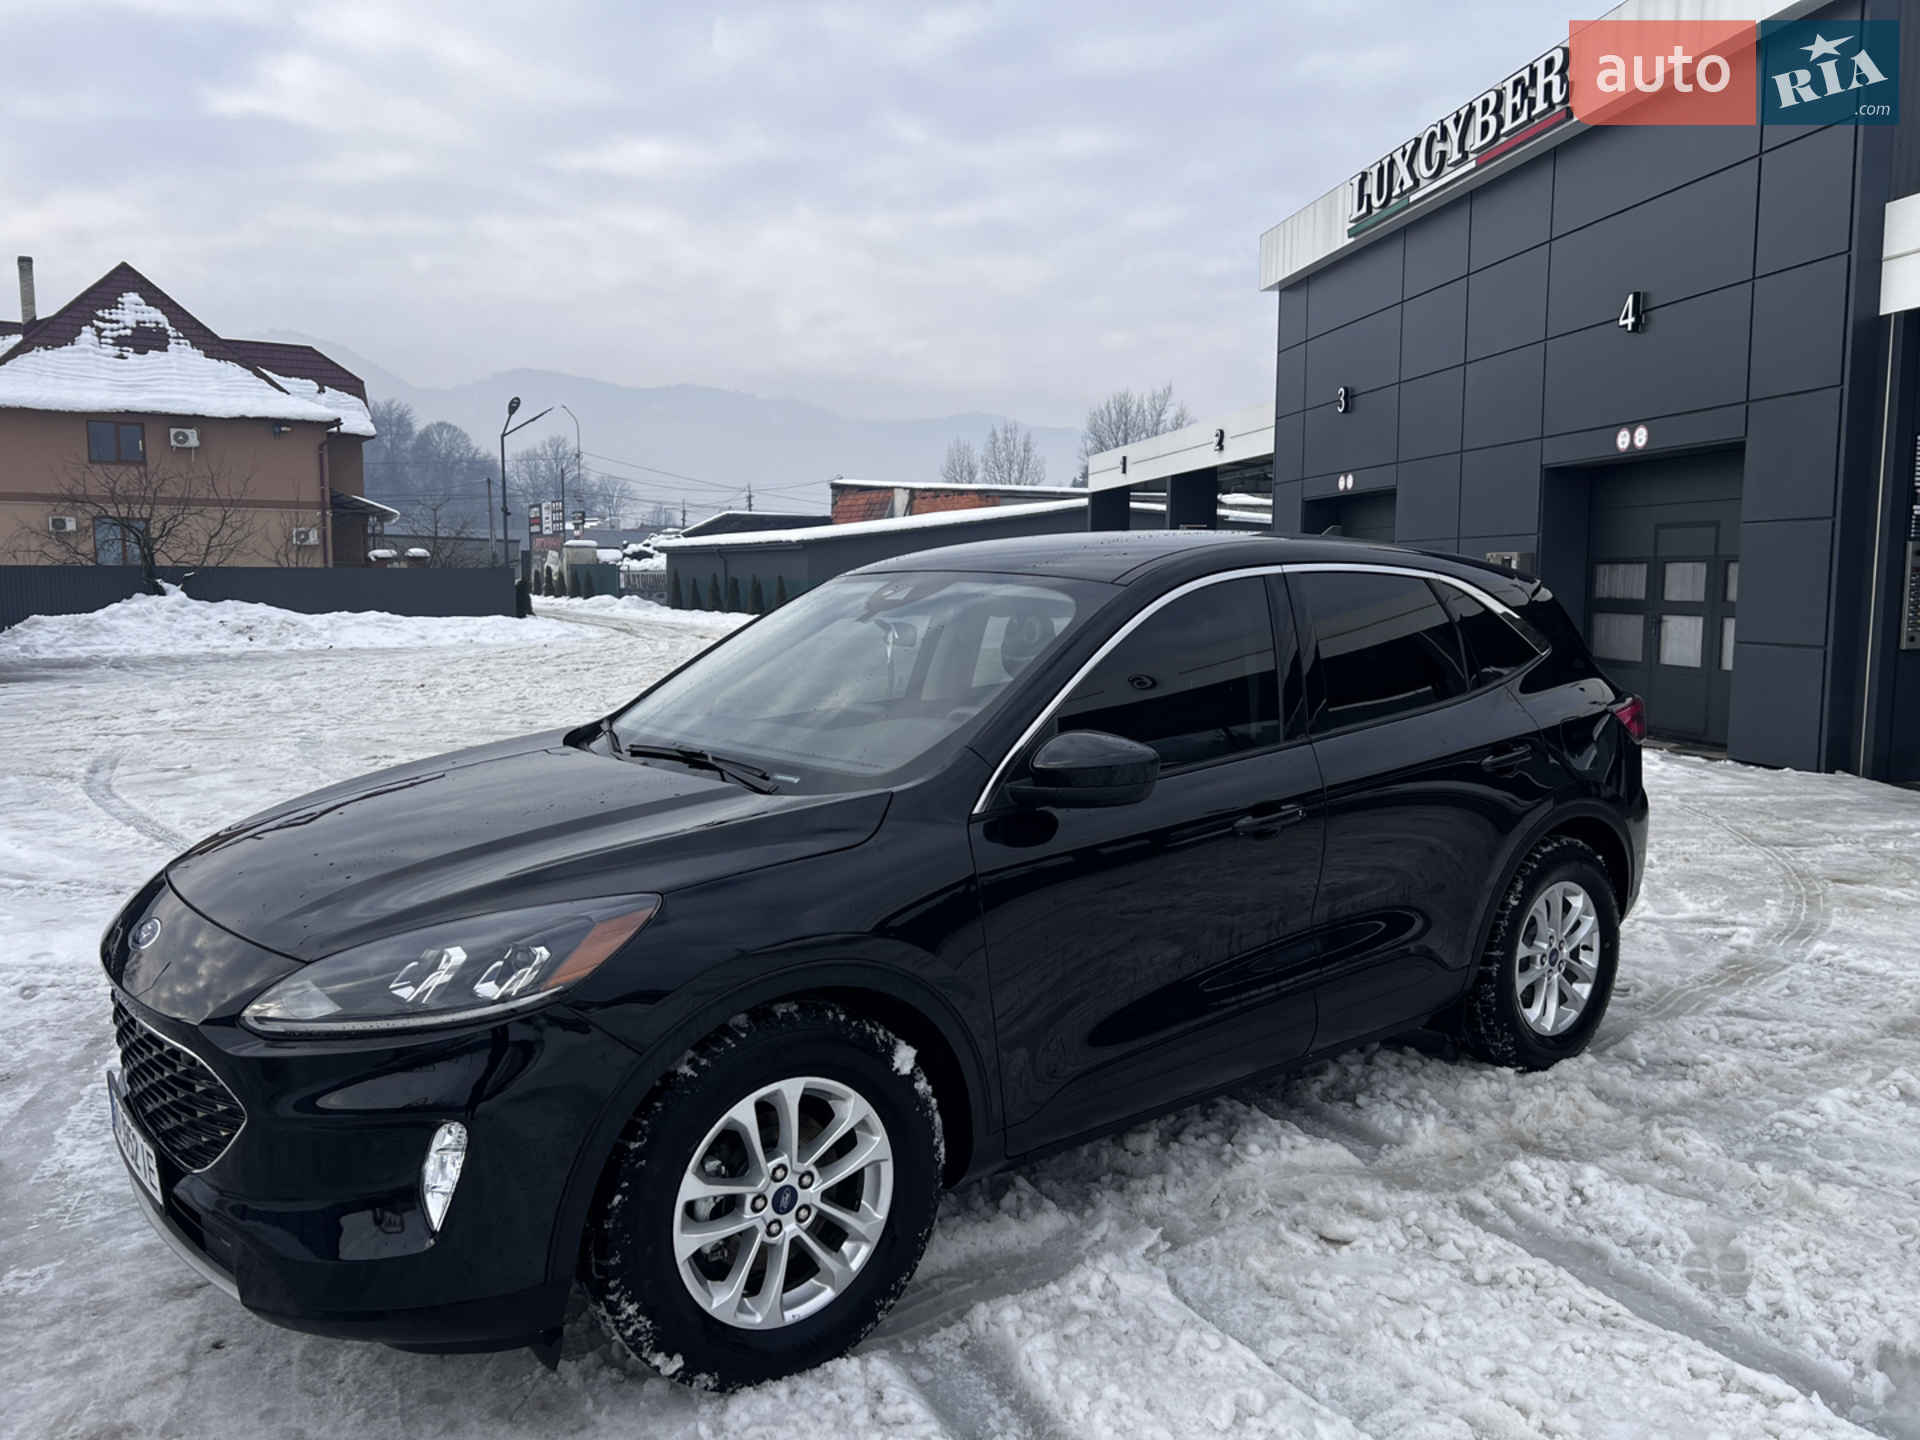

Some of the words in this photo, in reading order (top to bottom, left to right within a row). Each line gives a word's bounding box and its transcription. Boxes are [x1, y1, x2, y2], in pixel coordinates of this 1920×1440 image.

[1349, 47, 1570, 223] LUXCYBER
[1618, 292, 1640, 332] 4
[1337, 387, 1348, 413] 3
[1214, 428, 1224, 451] 2
